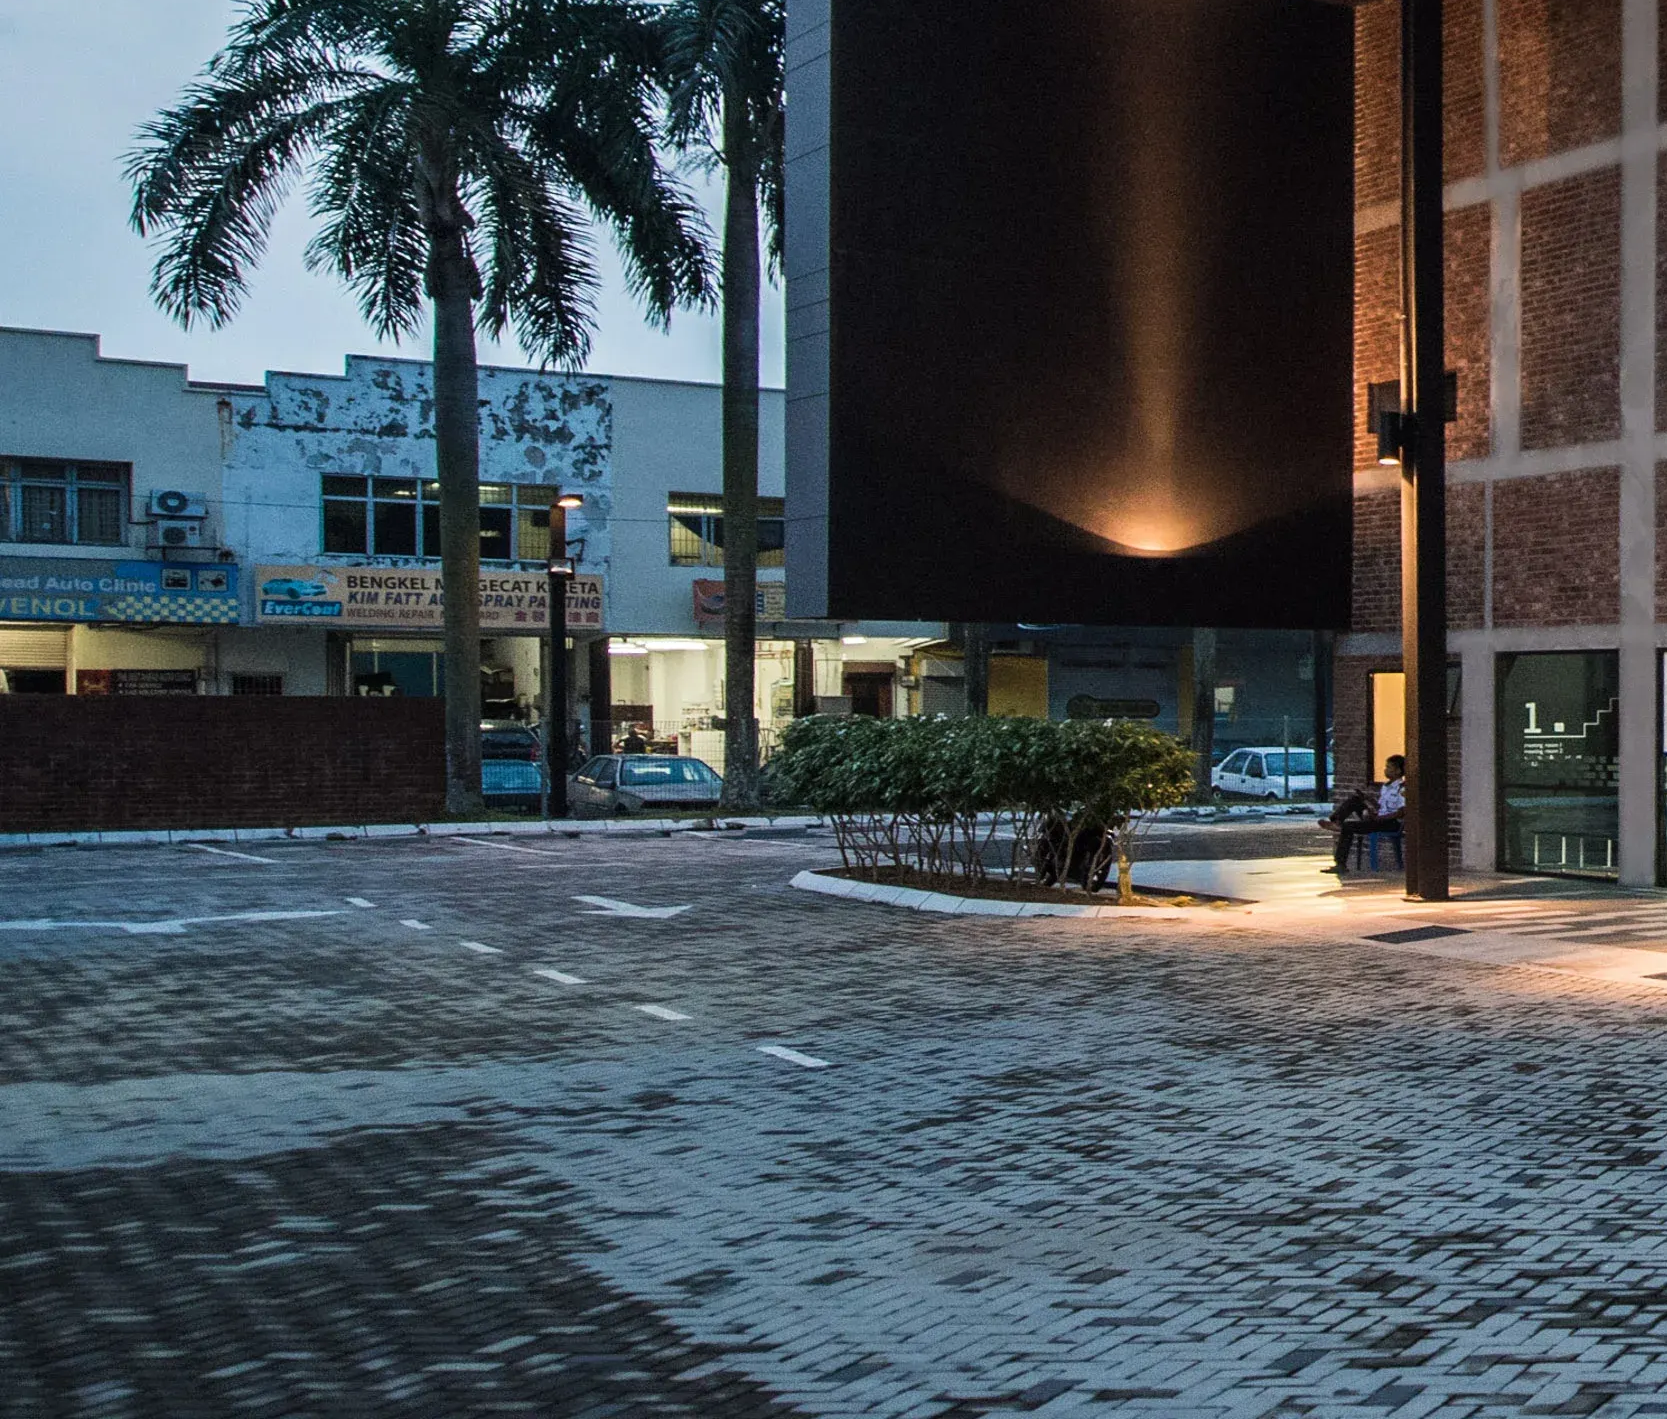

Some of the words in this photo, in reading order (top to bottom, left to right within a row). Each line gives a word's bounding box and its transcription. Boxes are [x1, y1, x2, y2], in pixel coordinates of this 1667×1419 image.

[0, 576, 39, 590] ead
[45, 577, 94, 592] Auto
[347, 575, 429, 590] BENGKEL
[347, 591, 379, 605] KIM
[385, 591, 424, 606] FATT
[528, 595, 602, 610] PATING
